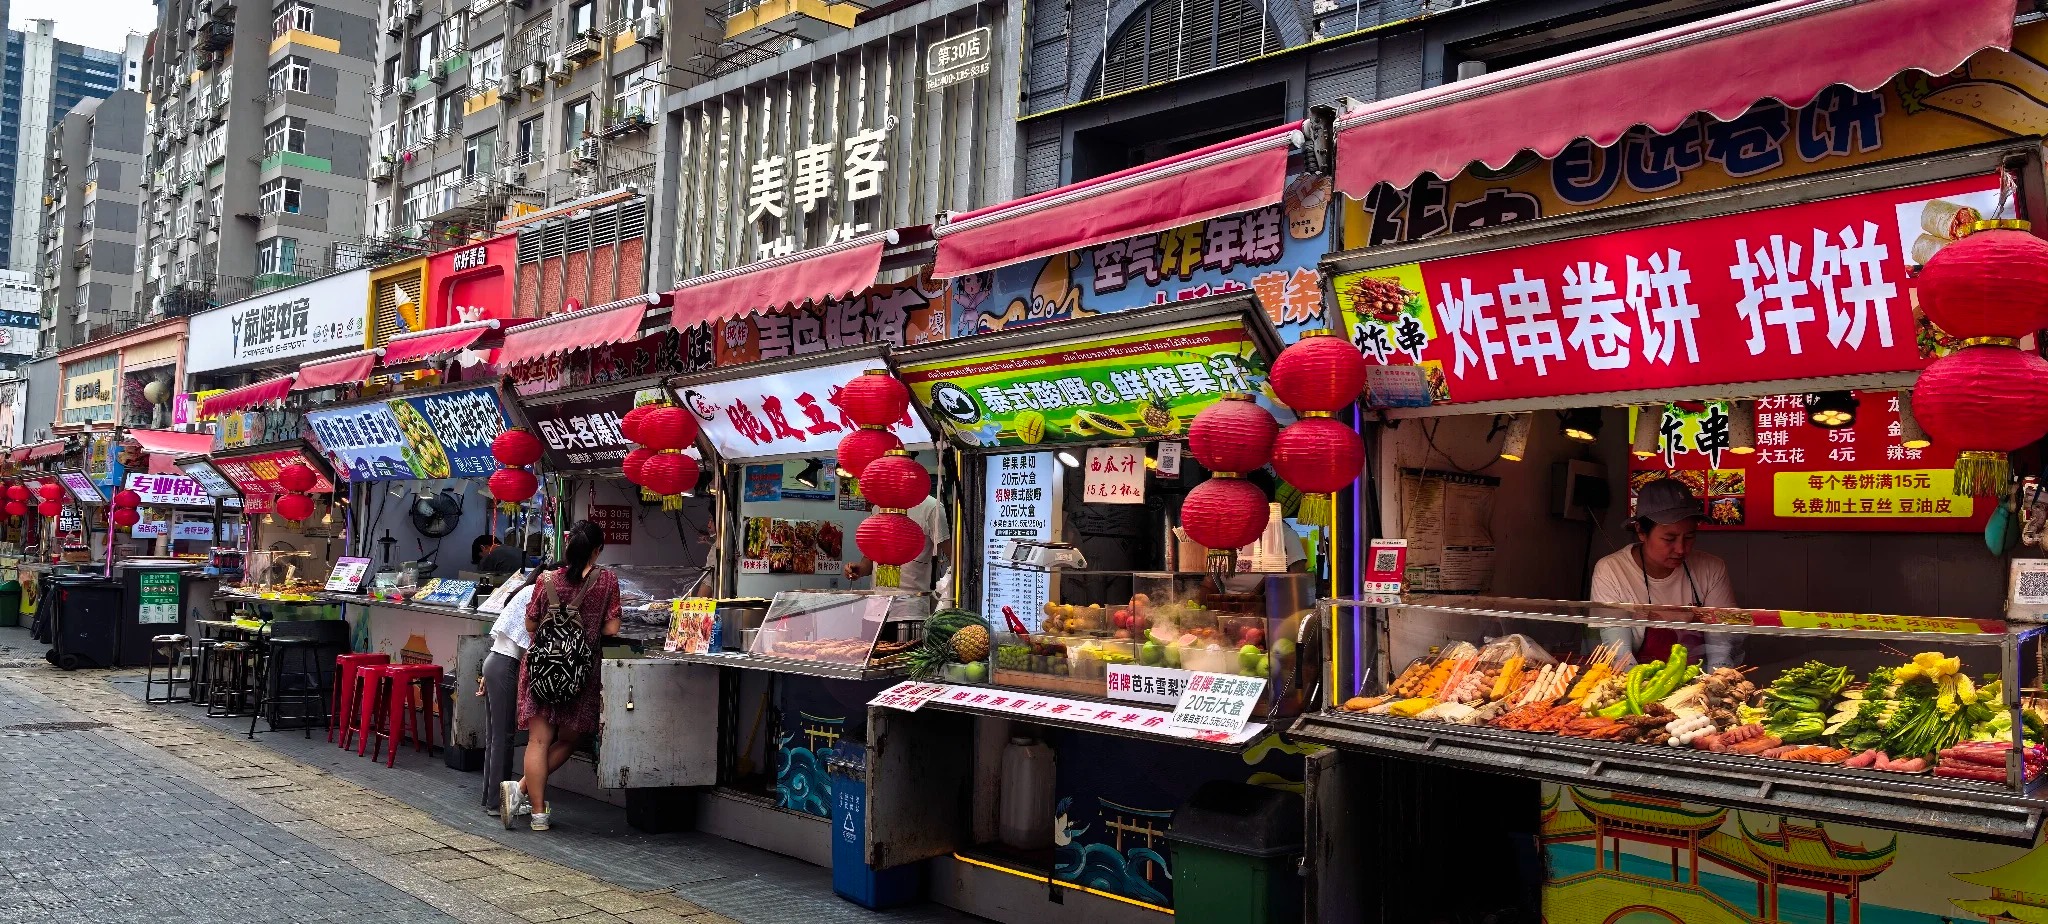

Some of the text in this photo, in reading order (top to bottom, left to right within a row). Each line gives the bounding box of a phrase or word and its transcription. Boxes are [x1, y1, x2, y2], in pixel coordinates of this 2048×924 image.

[937, 36, 981, 68] 第30店
[748, 128, 888, 224] 美事客
[453, 246, 486, 272] 你好青岛
[1092, 207, 1284, 294] 空气炸年糕
[1437, 220, 1897, 381] 炸串卷饼 拌饼
[1354, 314, 1429, 367] 炸串
[977, 360, 1250, 414] 泰式酸嘢&鲜榨果汁
[1758, 411, 1806, 429] 里脊排
[1757, 429, 1856, 446] 鸡排 5元
[1002, 455, 1036, 471] 鲜果果切
[1756, 447, 1856, 465] 大五花 4元
[1887, 445, 1923, 460] 辣条
[1090, 453, 1138, 476] 西瓜汁
[1001, 471, 1037, 486] 20元/大盒
[1807, 474, 1931, 490] 每个卷饼满15元
[1791, 497, 1952, 515] 免费加土豆丝 豆油皮
[1188, 674, 1263, 699] 招牌泰式酸嘢
[1184, 694, 1245, 717] 20元/大盒
